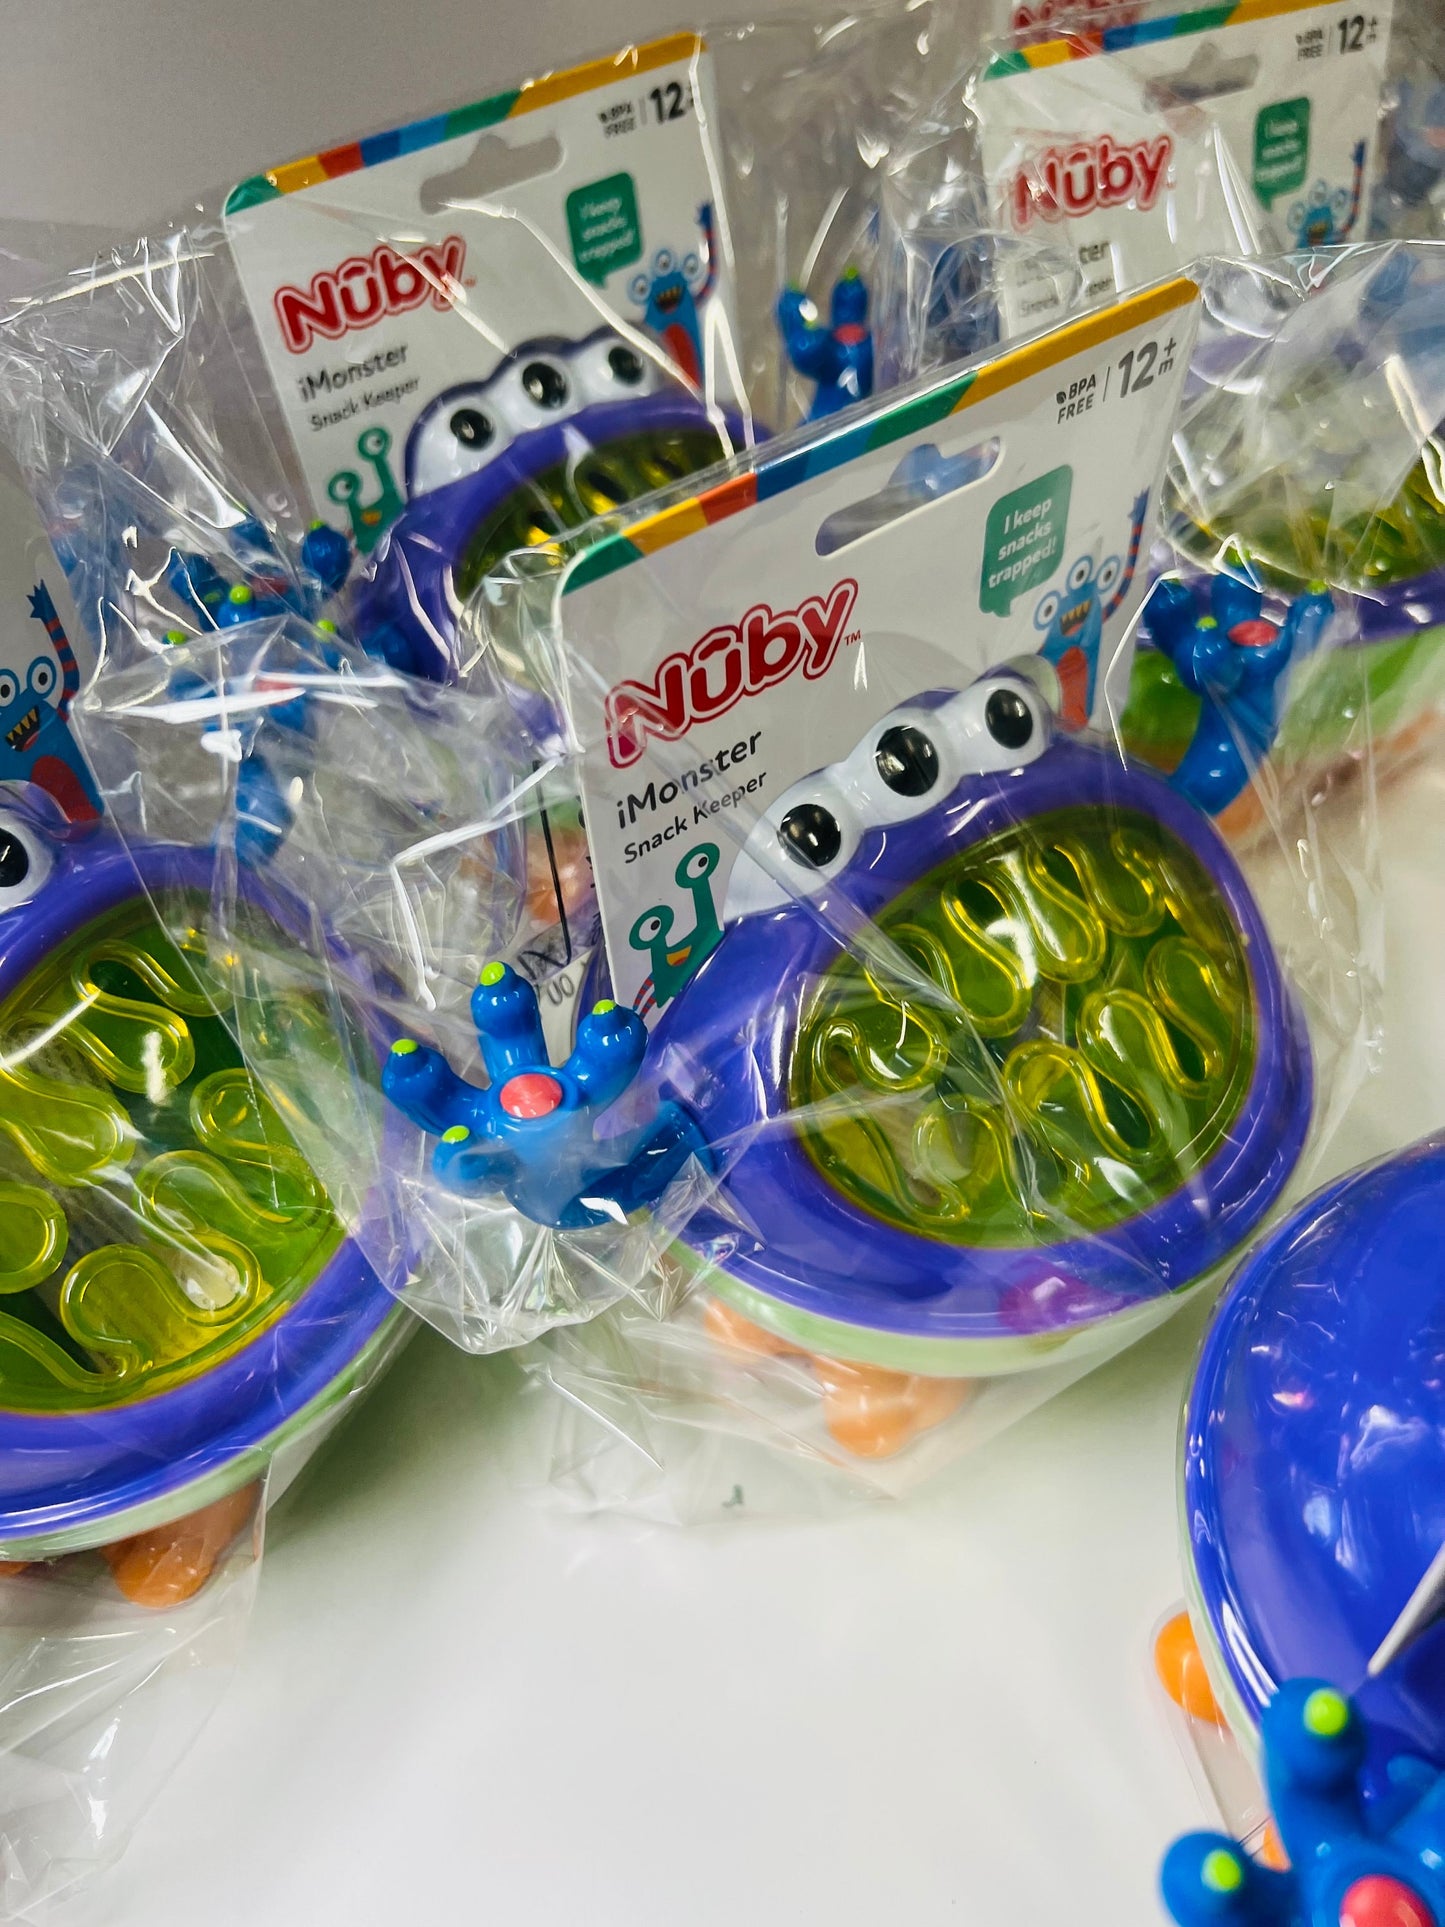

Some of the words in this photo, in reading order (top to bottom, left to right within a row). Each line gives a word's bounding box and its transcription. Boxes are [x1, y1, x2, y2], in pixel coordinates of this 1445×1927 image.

[297, 343, 408, 403] iMonster
[1067, 373, 1097, 400] BPA
[1057, 393, 1095, 425] FREE
[1013, 498, 1053, 530] keep
[988, 535, 1058, 589] trapped!
[998, 520, 1052, 561] snacks
[616, 731, 762, 829] iMonster
[624, 815, 688, 864] Snack
[693, 771, 767, 824] Keeper
